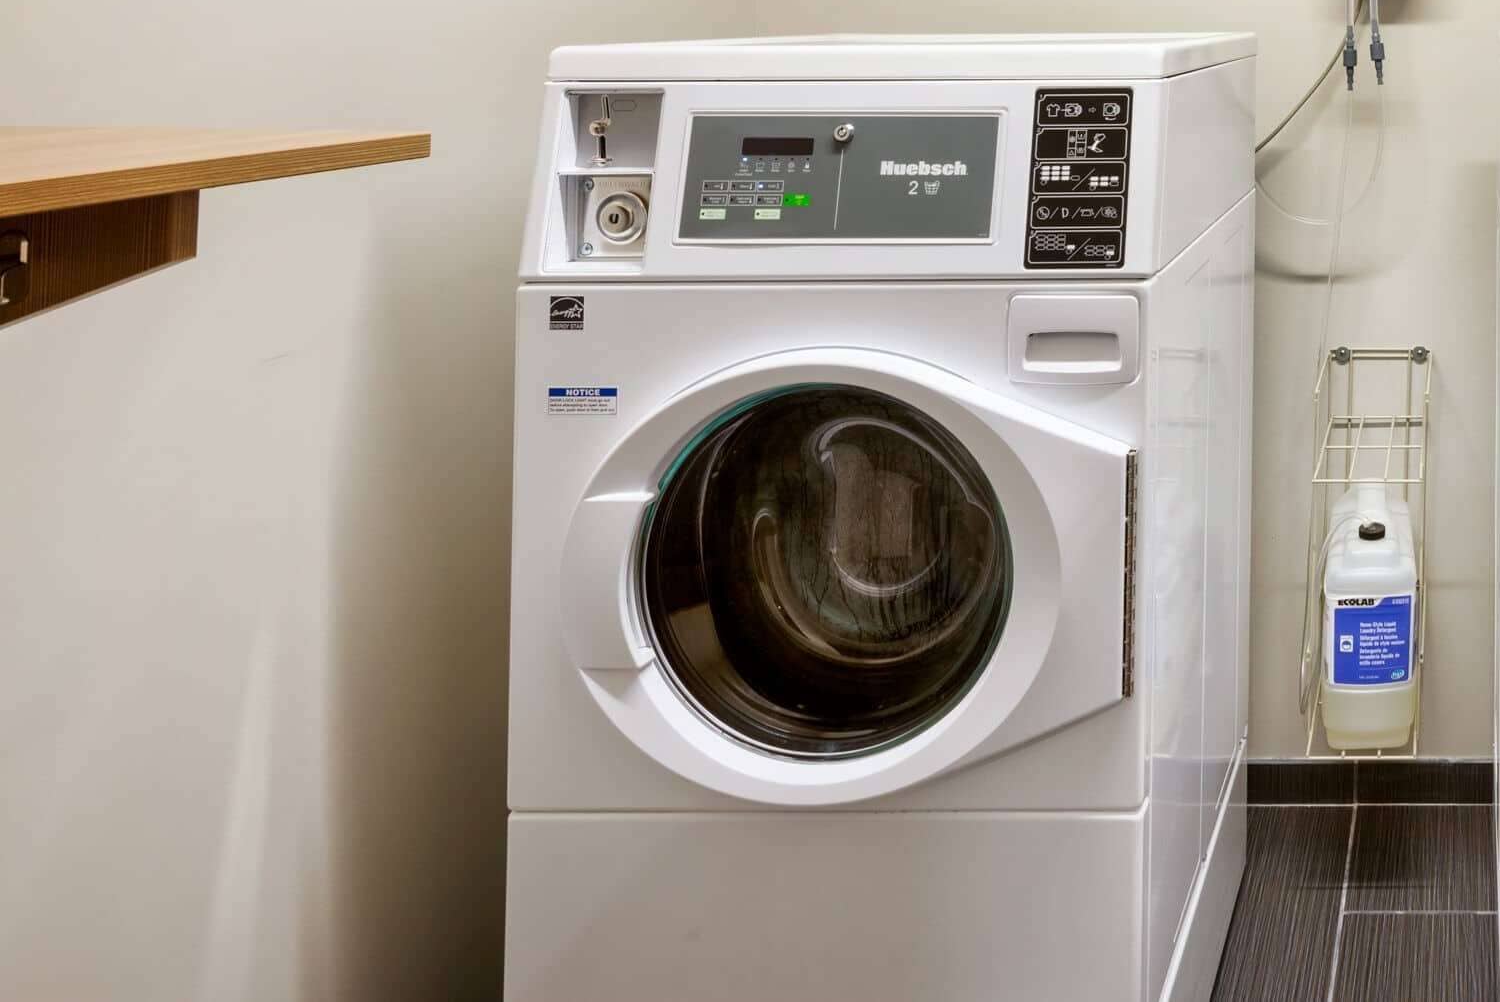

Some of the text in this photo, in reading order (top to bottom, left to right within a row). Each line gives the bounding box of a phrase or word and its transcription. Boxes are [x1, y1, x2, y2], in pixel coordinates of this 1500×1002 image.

[879, 160, 969, 176] Huebsch
[908, 180, 918, 195] 2
[565, 388, 600, 396] NOTICE
[1338, 598, 1375, 606] ECOLAB
